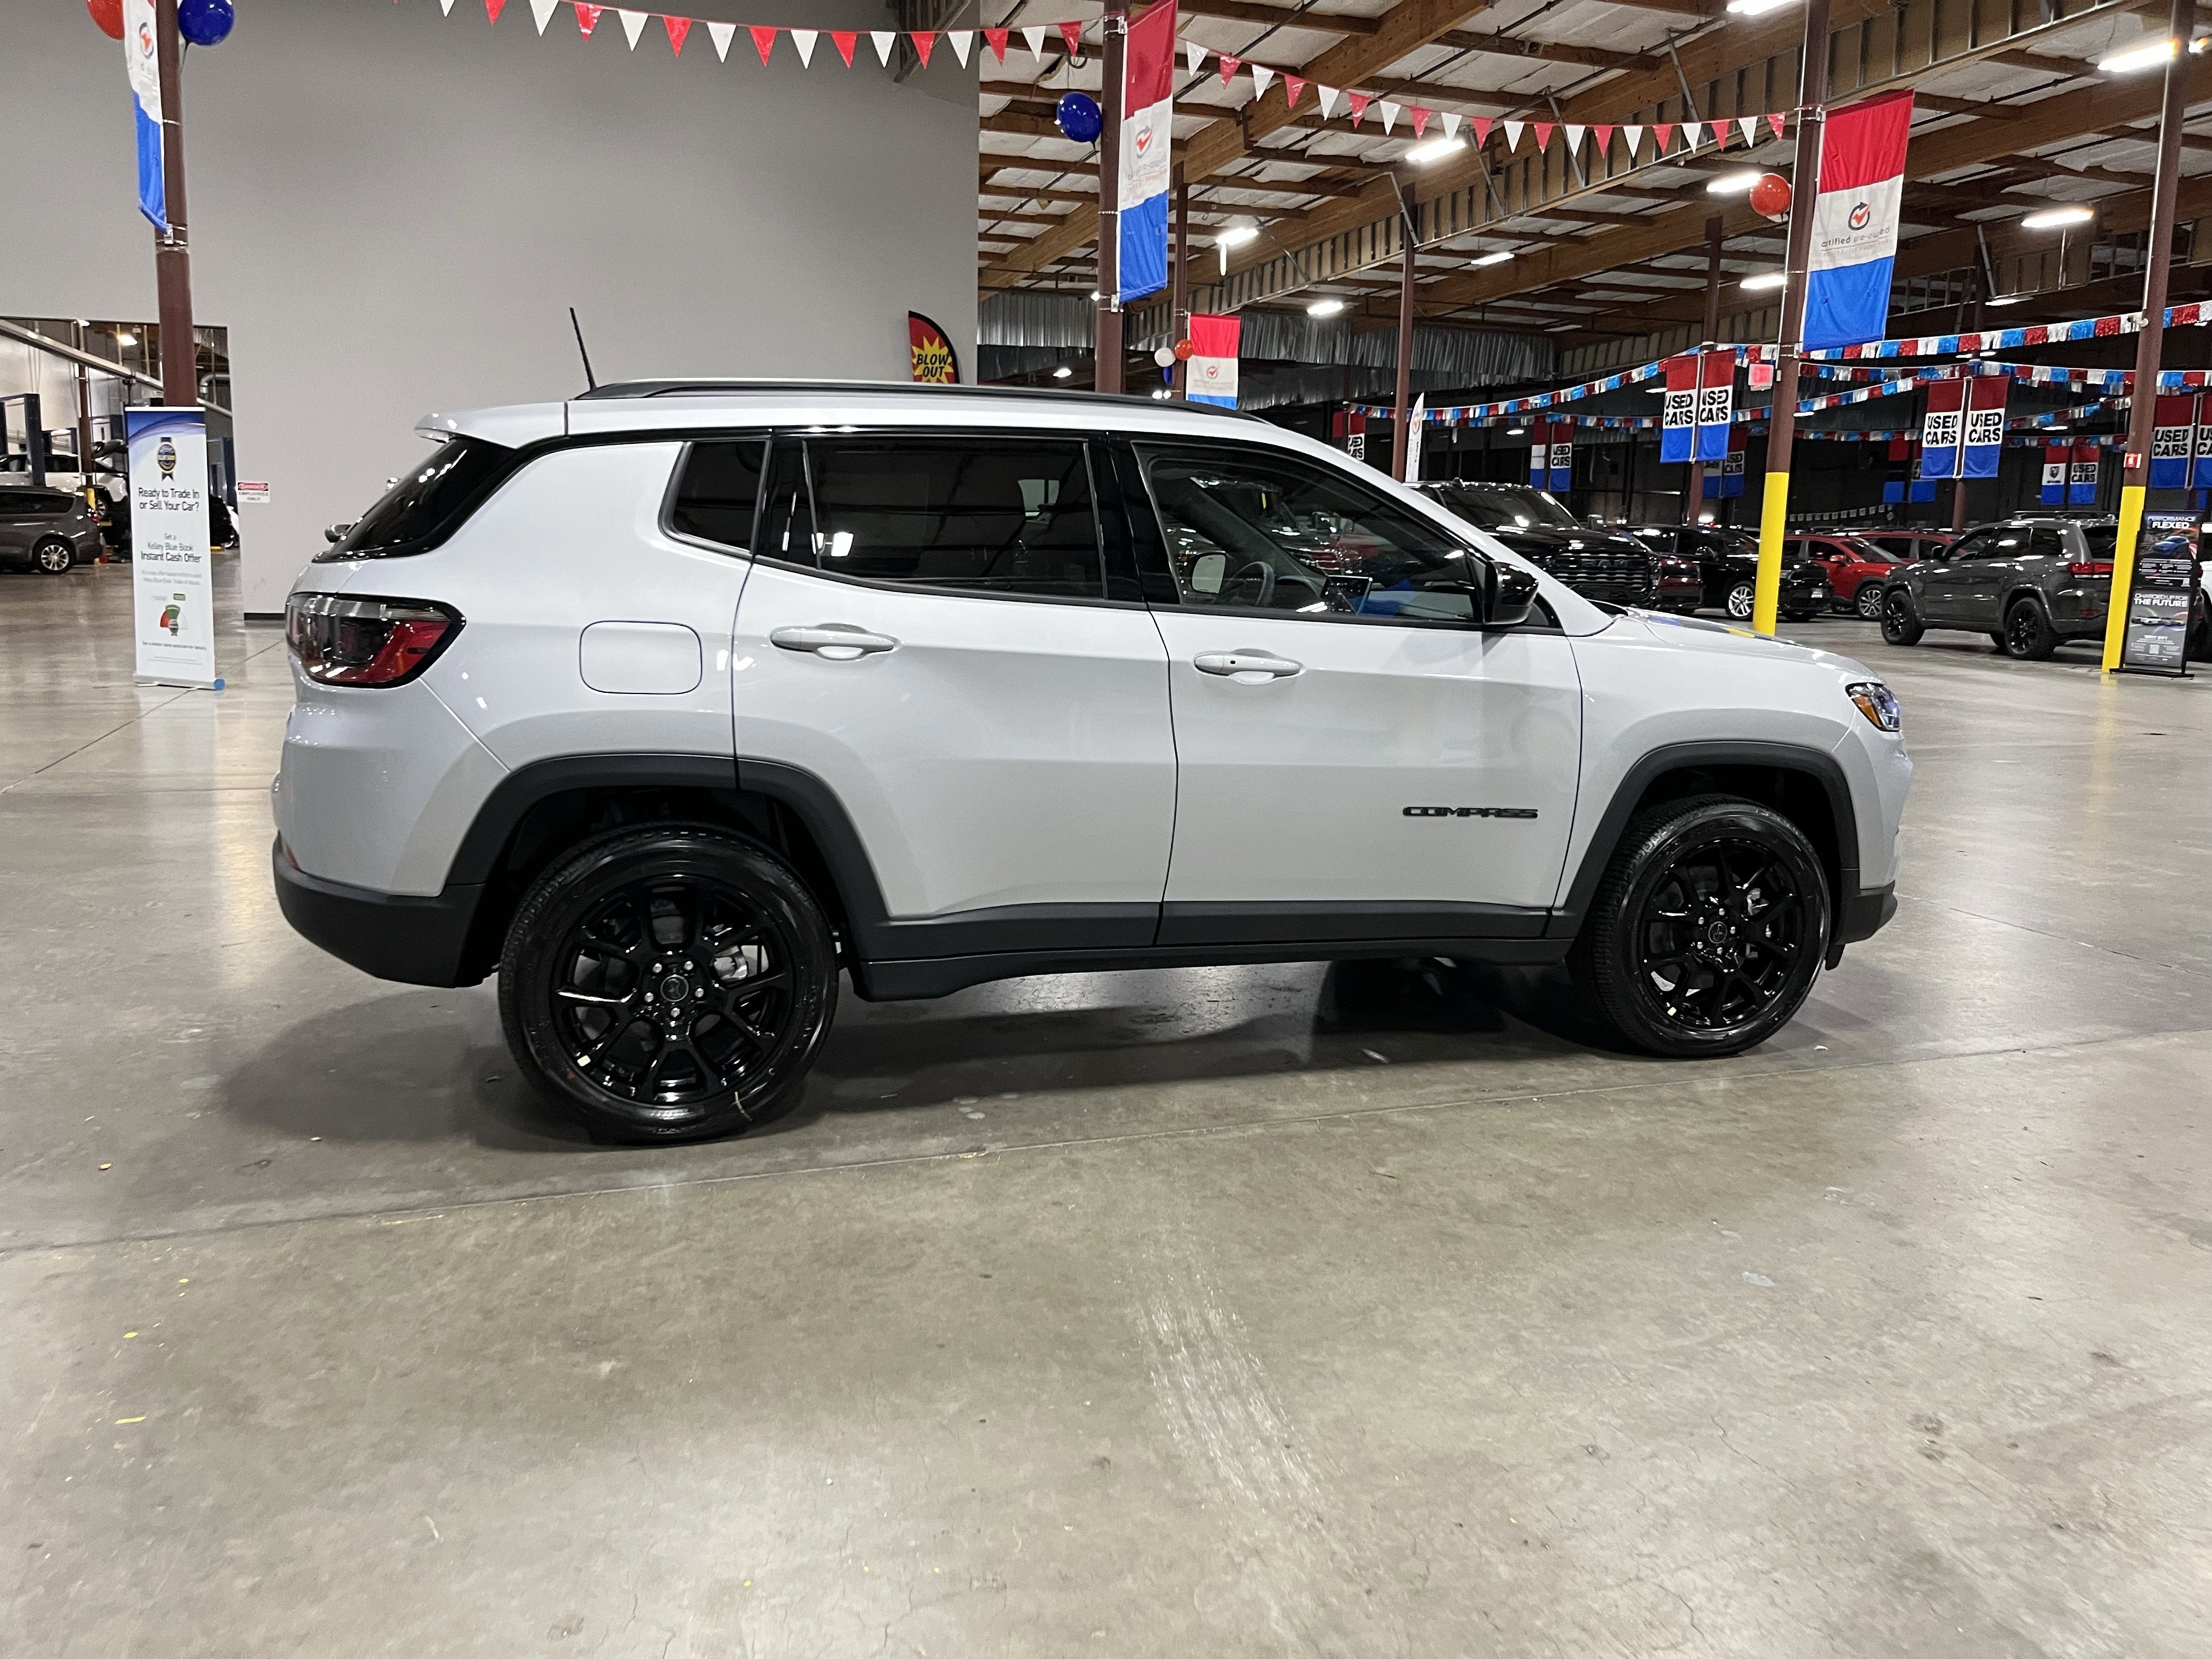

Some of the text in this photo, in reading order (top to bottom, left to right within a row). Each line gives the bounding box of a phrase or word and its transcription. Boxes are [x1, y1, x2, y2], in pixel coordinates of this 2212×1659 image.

[917, 354, 949, 365] BLOW
[923, 366, 945, 377] OUT
[1665, 394, 1693, 409] USED
[1702, 389, 1729, 405] USED
[1665, 410, 1693, 426] CARS
[1700, 406, 1728, 422] CARS
[1971, 413, 2002, 427] USED
[1927, 415, 1957, 429] USED
[1926, 430, 1956, 444] CARS
[1968, 428, 2001, 443] CARS
[2154, 429, 2189, 442] USED
[1554, 445, 1570, 455] USED
[2153, 443, 2187, 456] CARS
[2073, 464, 2096, 473] USED
[2072, 473, 2095, 482] CARS
[138, 487, 199, 500] Ready to Trade In
[149, 500, 163, 510] Sell
[164, 500, 180, 510] Your
[182, 501, 199, 511] Car?
[165, 542, 178, 551] Blue
[179, 543, 194, 551] Book
[141, 551, 201, 563] Instant Cash Offer
[2152, 599, 2188, 607] FUTURE
[1403, 807, 1538, 819] COMPASS
